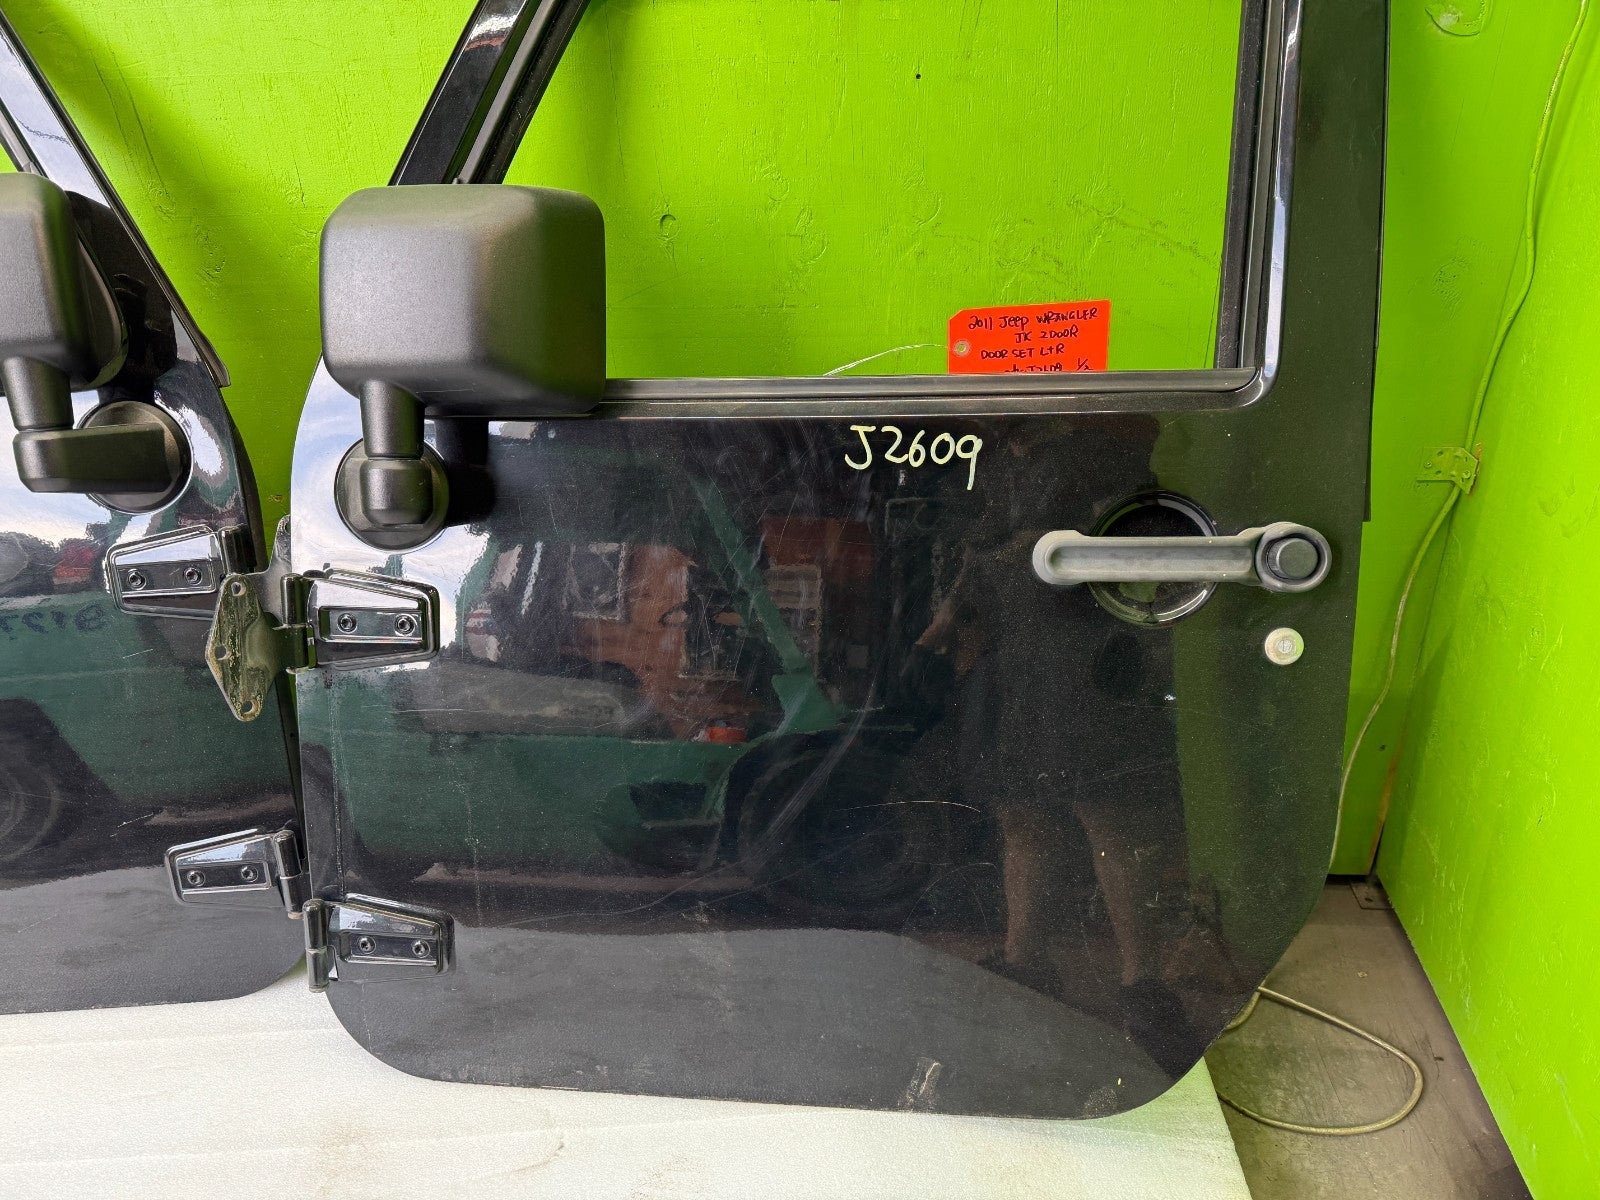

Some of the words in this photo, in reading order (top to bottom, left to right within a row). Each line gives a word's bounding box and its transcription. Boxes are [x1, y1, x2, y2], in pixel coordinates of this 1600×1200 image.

[968, 315, 993, 331] 2011
[999, 315, 1030, 332] Jeep
[1014, 331, 1033, 344] JK
[981, 349, 1009, 360] DOOR
[1012, 347, 1034, 359] SET
[845, 425, 983, 491] J2609
